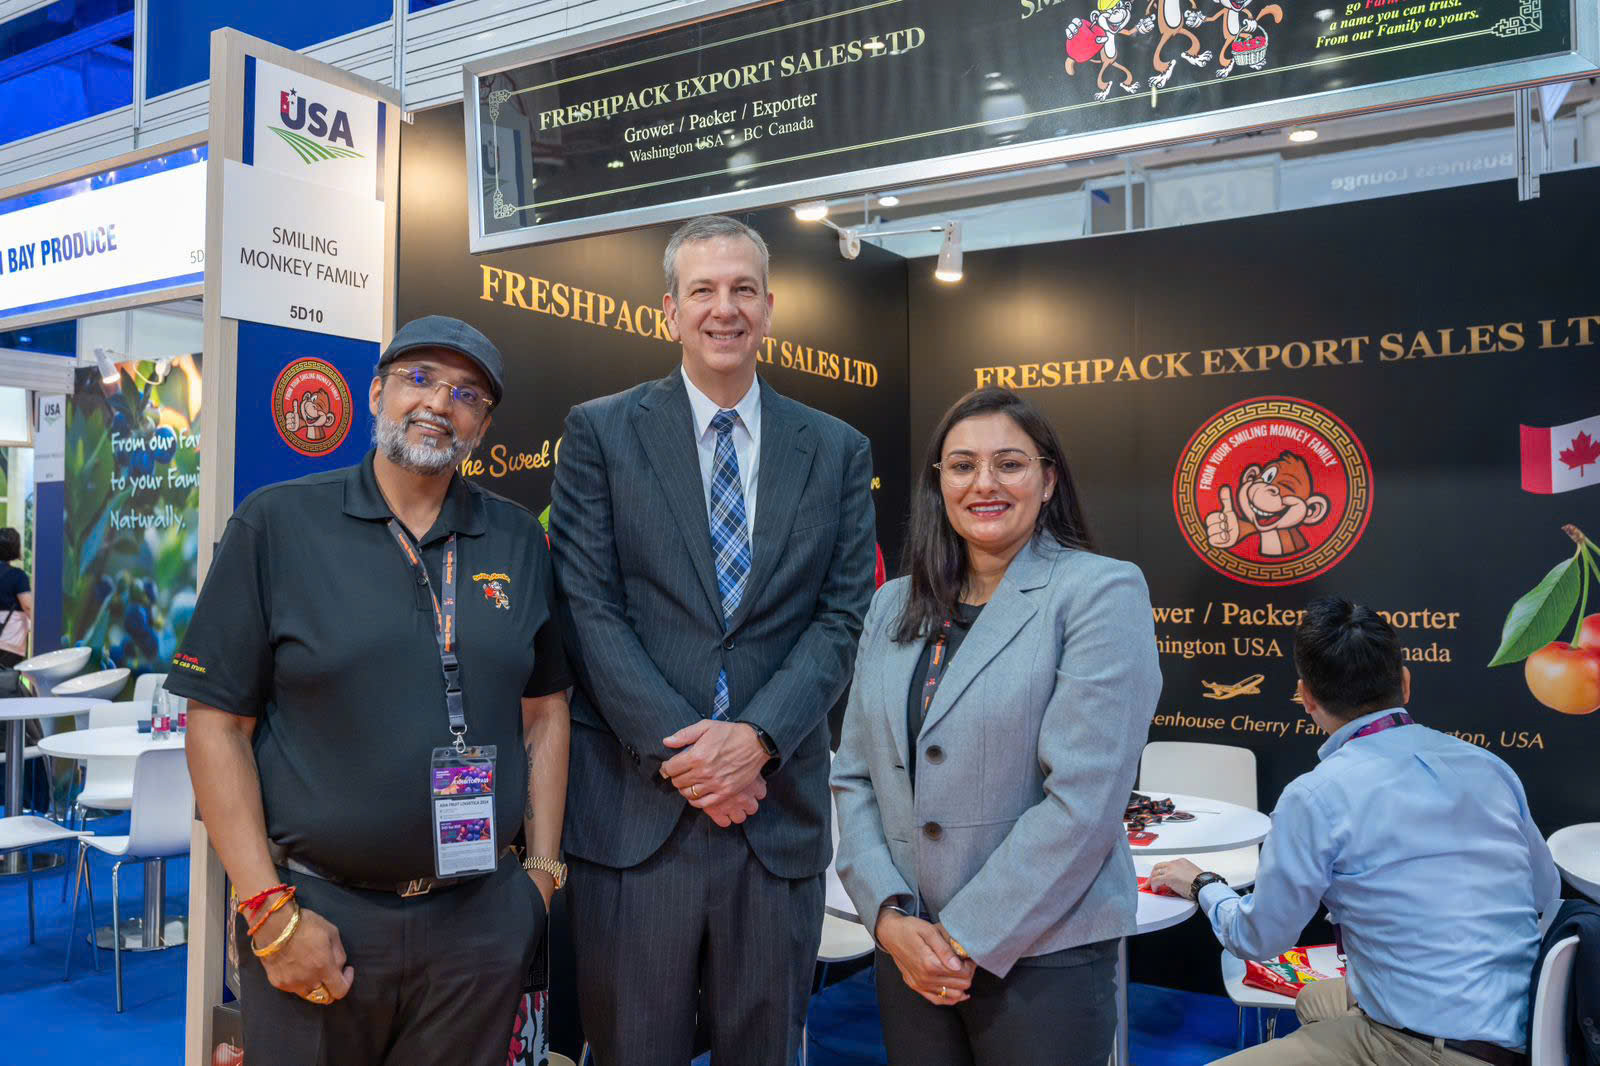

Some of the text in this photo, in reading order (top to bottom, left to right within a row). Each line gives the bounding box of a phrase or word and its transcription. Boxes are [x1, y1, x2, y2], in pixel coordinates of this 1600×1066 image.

[1329, 22, 1337, 31] a
[1340, 14, 1374, 29] name
[1376, 9, 1400, 25] you
[1403, 4, 1426, 17] can
[1345, 2, 1361, 16] go
[1316, 9, 1479, 48] From our Family to yours.
[538, 26, 926, 131] FRESHPACK EXPORT SALES LTD
[280, 88, 354, 148] USA
[624, 121, 675, 143] Grower
[689, 109, 737, 130] Packer
[752, 92, 818, 118] Exporter
[629, 116, 814, 163] Washington USA BC Canada
[7, 242, 36, 273] BAY
[41, 223, 118, 266] PRODUCE
[190, 249, 205, 264] 5D
[272, 226, 338, 257] SMILING
[240, 247, 369, 289] MONKEY FAMILY
[290, 305, 323, 324] 5D10
[480, 264, 673, 342] FRESHPACK
[781, 340, 840, 380] SALES
[843, 357, 878, 388] LTD
[974, 316, 1600, 390] FRESHPACK EXPORT SALES LT
[44, 403, 60, 416] USA
[111, 429, 200, 453] From our Far
[456, 450, 485, 477] he
[489, 440, 551, 478] Sweet
[1199, 423, 1339, 490] FROM YOUR SMILING MONKEY FAMILY
[110, 466, 200, 497] to your Fami
[110, 504, 186, 535] Naturally.
[1152, 606, 1195, 625] wer
[1222, 602, 1308, 626] Packer
[1155, 634, 1453, 663] hington USA nada
[1150, 711, 1225, 730] enhouse
[1230, 714, 1290, 737] Cherry
[1500, 730, 1545, 750] USA
